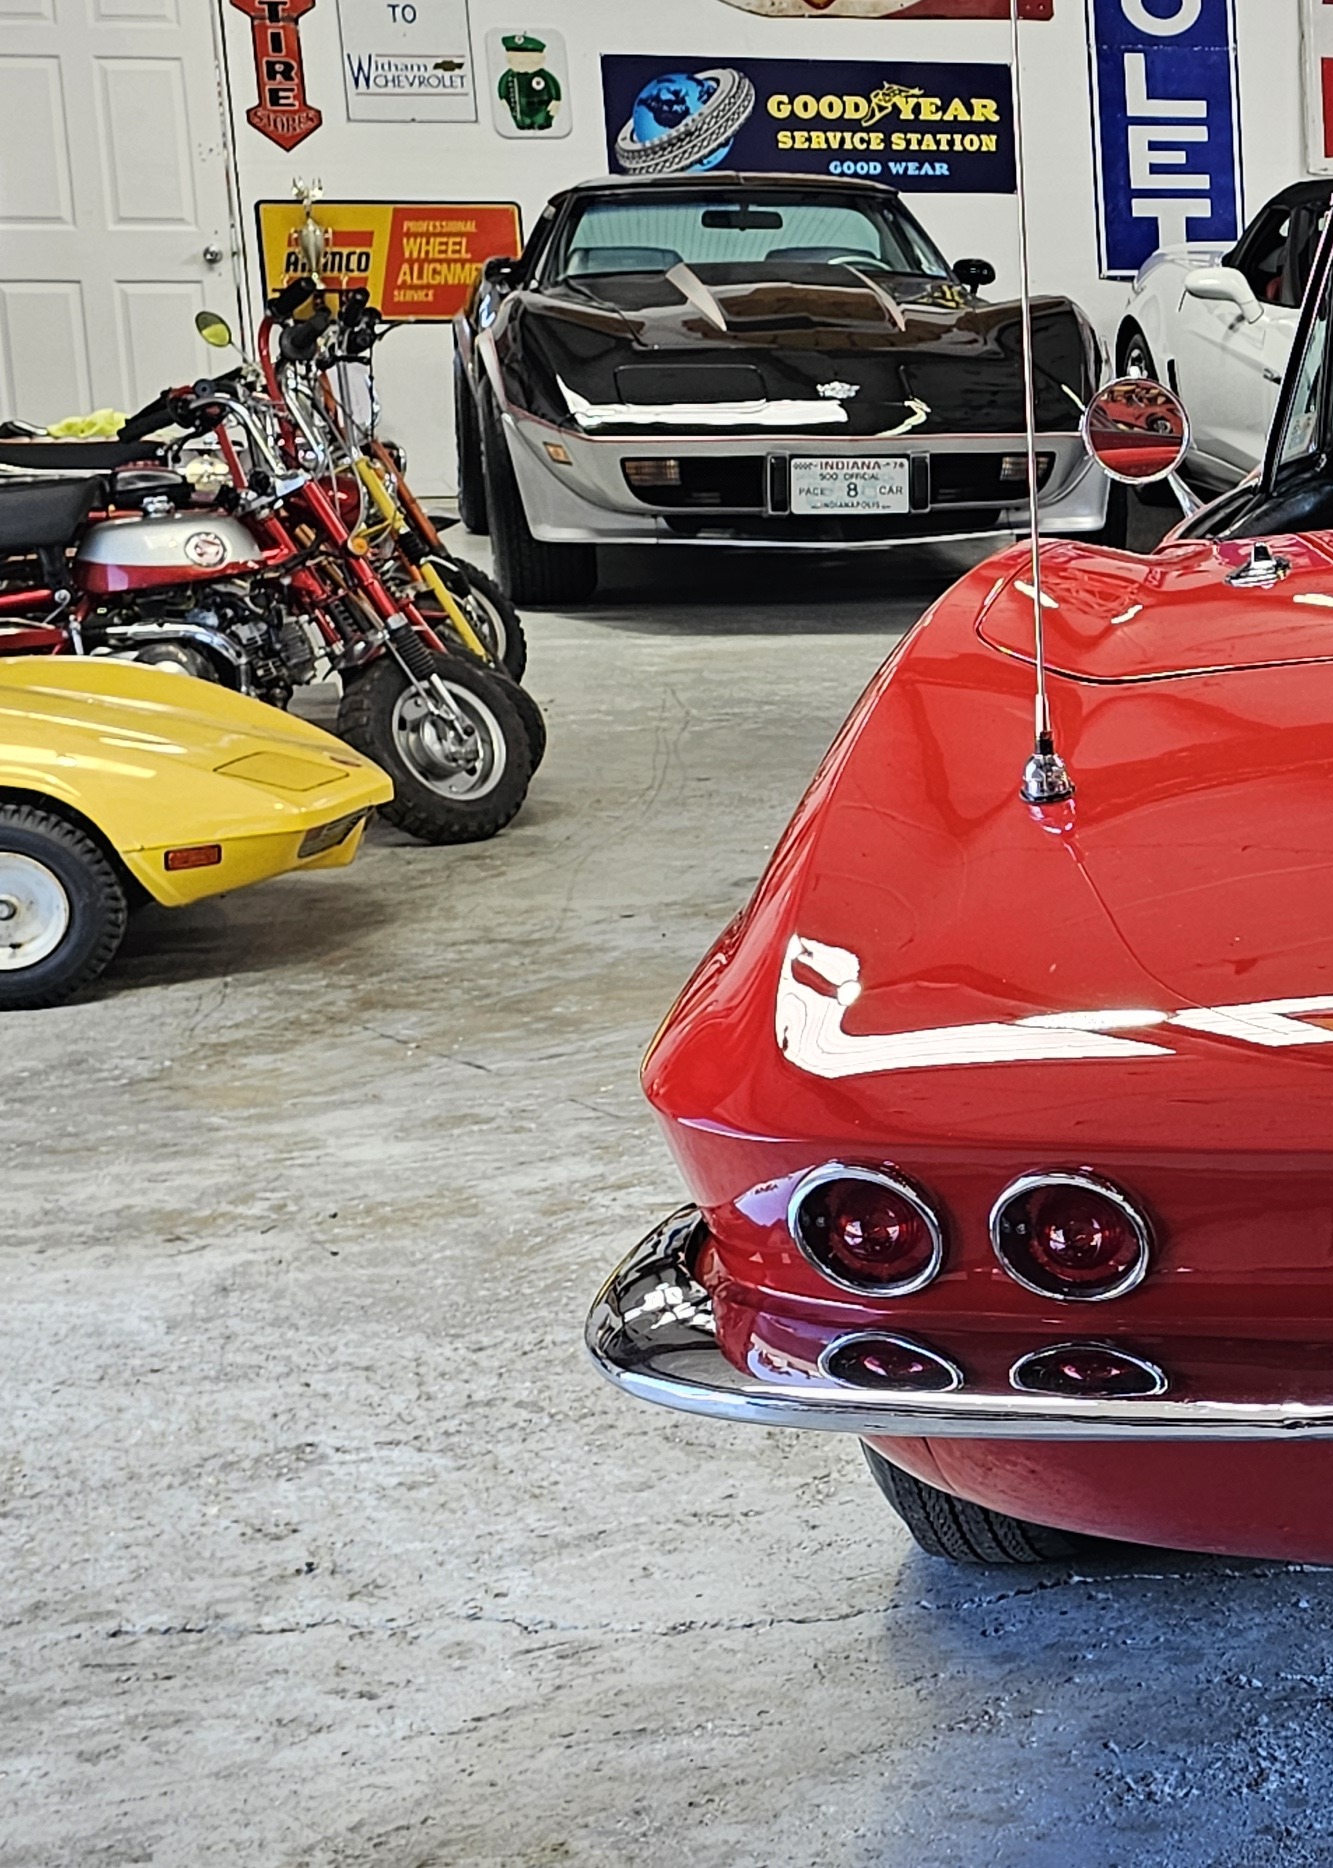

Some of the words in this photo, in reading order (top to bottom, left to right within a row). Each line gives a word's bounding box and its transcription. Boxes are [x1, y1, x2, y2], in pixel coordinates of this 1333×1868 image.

[386, 3, 417, 24] TO
[256, 0, 299, 109] TIRE
[373, 74, 466, 88] CHEVROLET
[252, 109, 317, 134] STORES
[777, 131, 884, 150] SERVICE
[890, 131, 997, 152] STATION
[828, 161, 881, 175] GOOD
[887, 161, 949, 176] WEAR
[402, 220, 477, 233] PROFESSIONAL
[402, 237, 472, 258] WHEEL
[394, 289, 434, 302] SERVICE
[819, 460, 881, 470] INDIANA
[846, 481, 859, 498] 8
[879, 485, 903, 496] CAR
